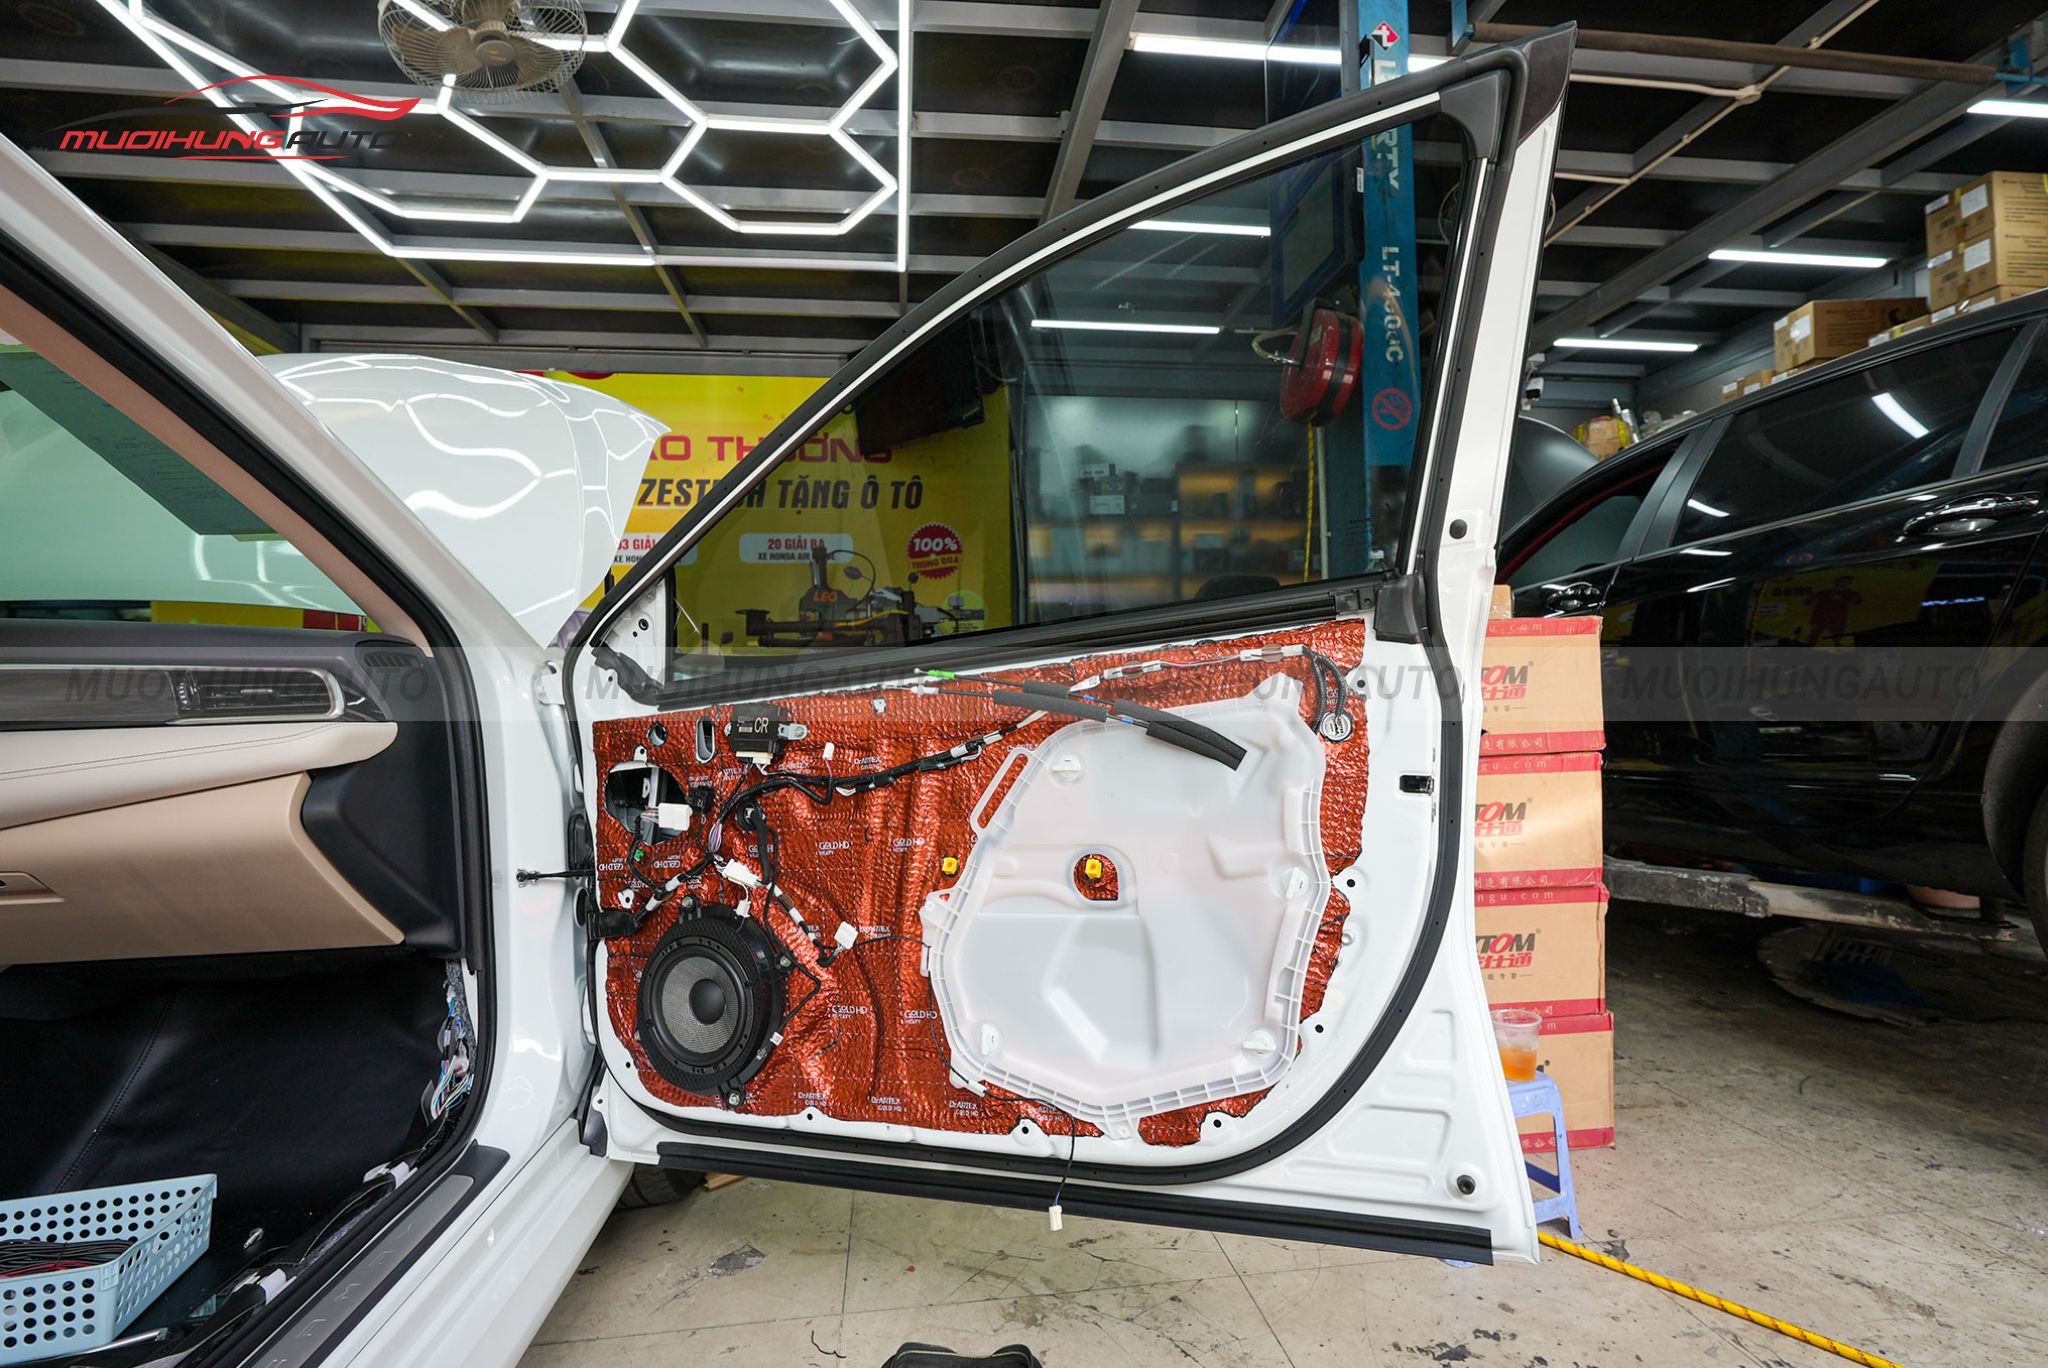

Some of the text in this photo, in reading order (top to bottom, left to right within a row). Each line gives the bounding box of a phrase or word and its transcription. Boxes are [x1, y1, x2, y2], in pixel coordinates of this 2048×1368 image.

[778, 475, 850, 514] TẶNG
[861, 475, 879, 509] Ô
[891, 475, 923, 510] TÔ
[768, 538, 781, 550] 20
[913, 537, 958, 552] 100%
[754, 717, 769, 733] CR
